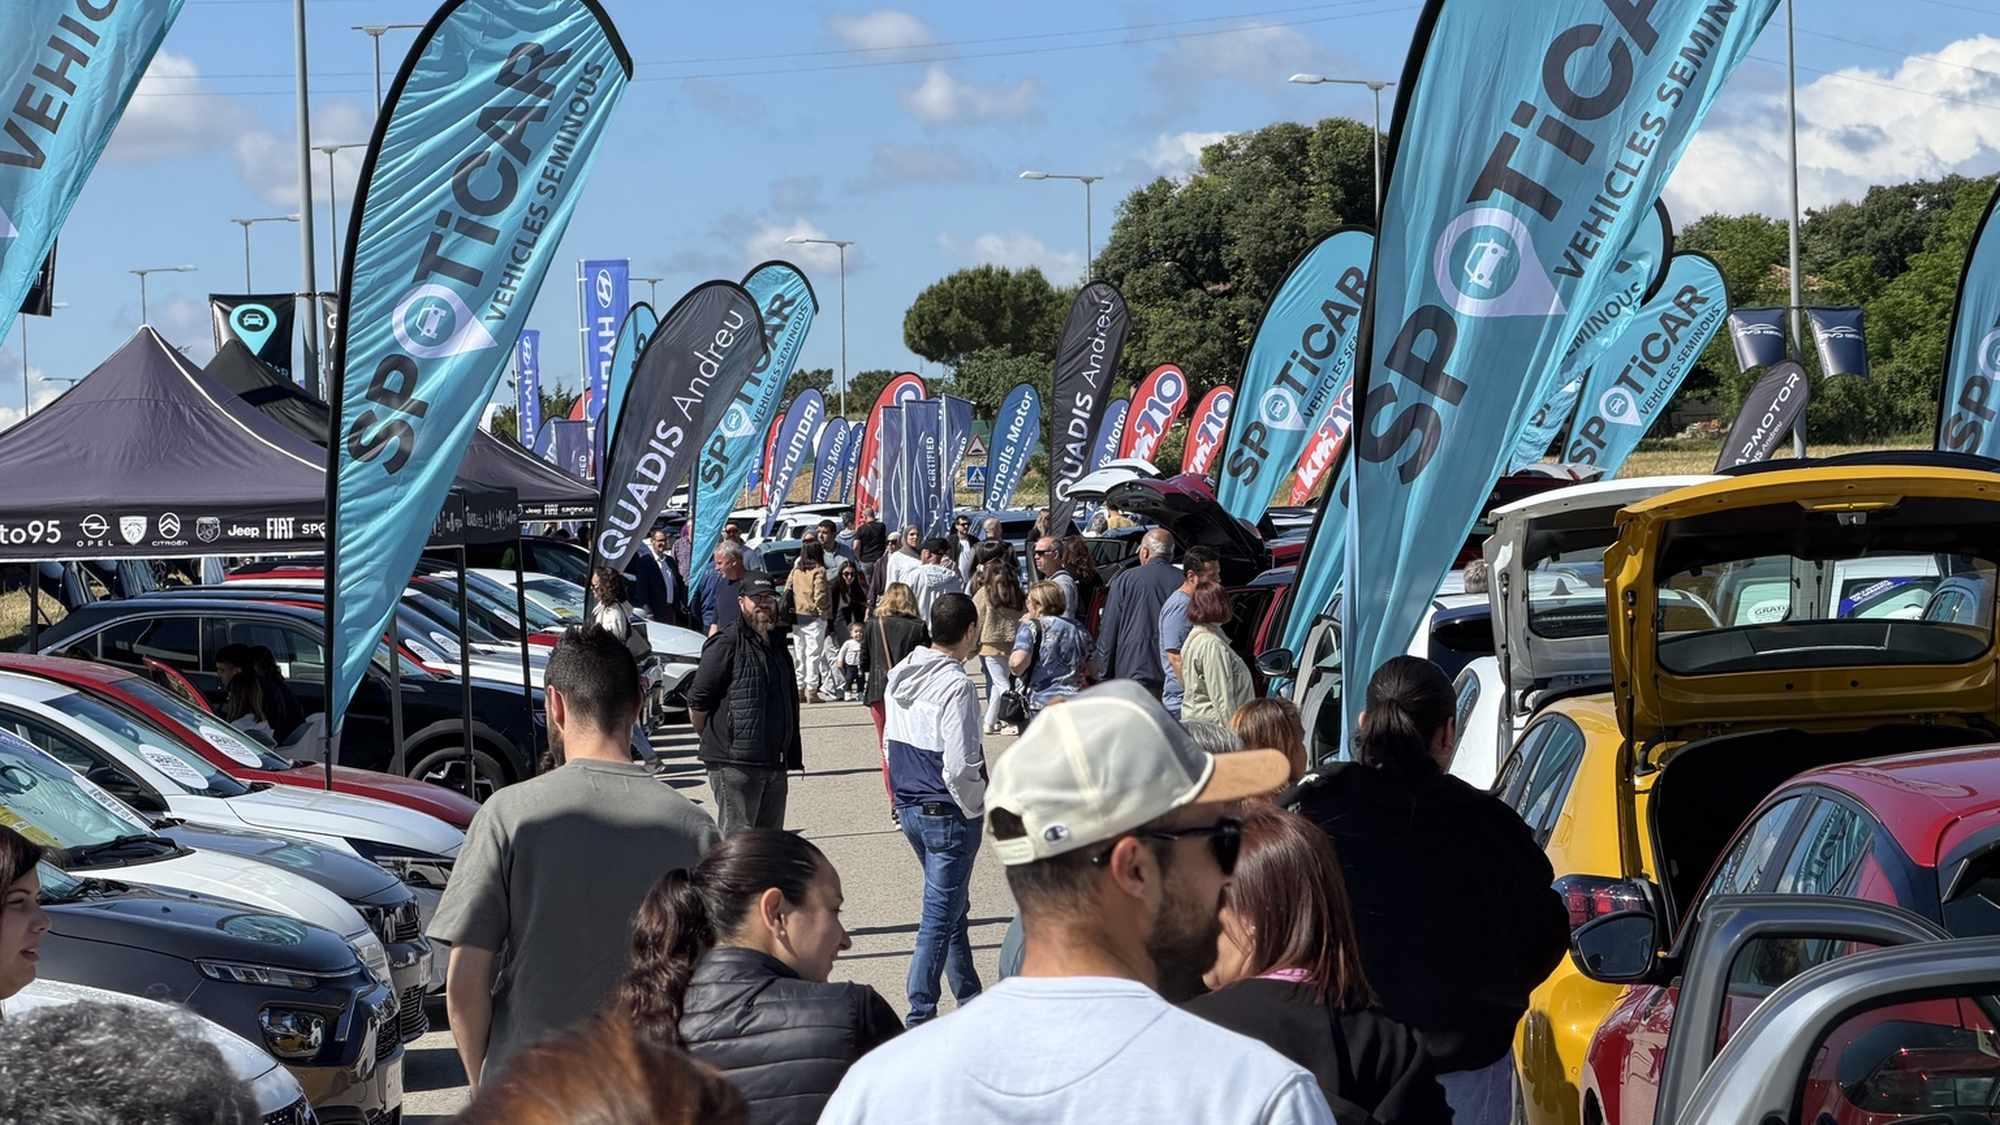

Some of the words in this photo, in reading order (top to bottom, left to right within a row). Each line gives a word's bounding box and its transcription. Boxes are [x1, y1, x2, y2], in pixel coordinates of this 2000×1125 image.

[485, 201, 549, 322] VEHICLES
[536, 62, 602, 201] SEMINOUS
[1554, 112, 1667, 280] VEHICLES
[752, 368, 782, 424] VEHICLES
[777, 304, 810, 367] SEMINOUS
[1055, 391, 1094, 503] QUADIS
[1081, 299, 1115, 389] Andreu
[1303, 357, 1347, 419] VEHICLES
[1639, 363, 1682, 417] VEHICLES
[1677, 307, 1722, 366] SEMINOUS
[596, 419, 685, 561] QUADIS
[670, 309, 744, 422] Andreu
[775, 398, 821, 491] HYUNDAI
[827, 424, 848, 465] Motor
[985, 444, 1016, 513] Fornells
[1006, 390, 1034, 444] Motor
[1105, 406, 1127, 454] Motor
[228, 524, 260, 539] Jeep
[266, 517, 295, 539] FIAT
